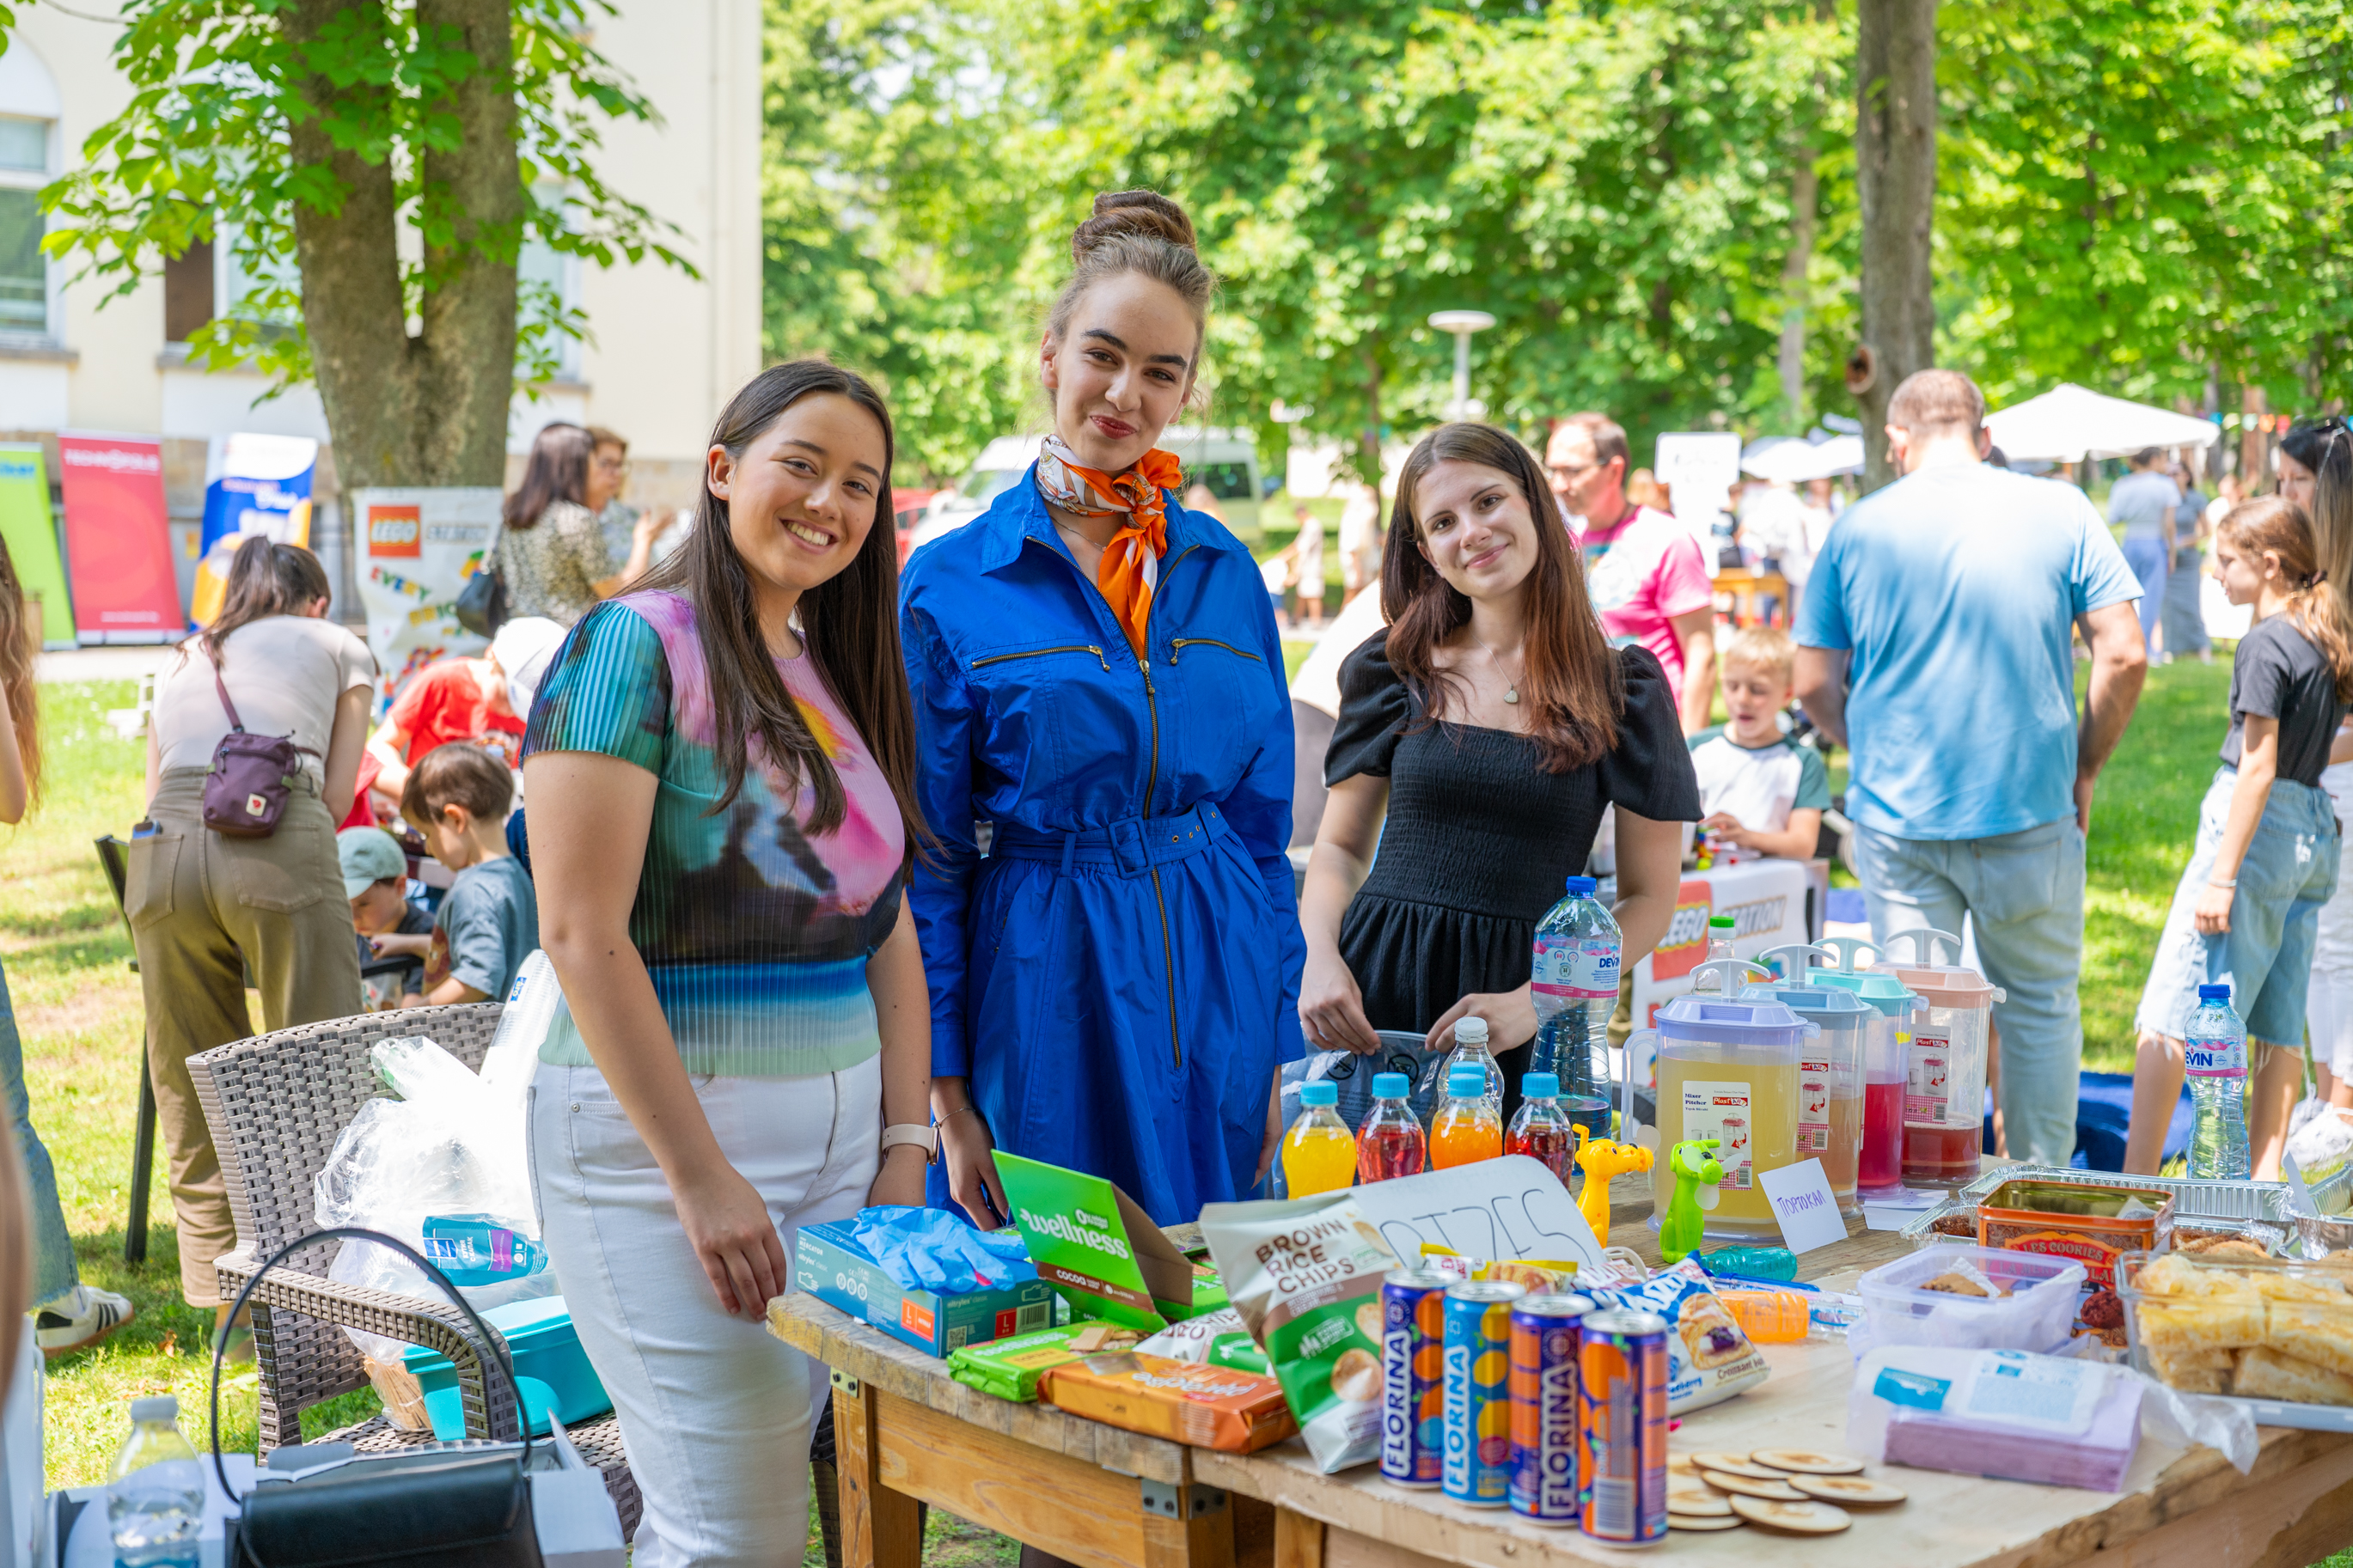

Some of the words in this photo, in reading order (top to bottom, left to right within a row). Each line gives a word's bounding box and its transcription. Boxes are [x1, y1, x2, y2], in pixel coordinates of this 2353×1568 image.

[371, 519, 419, 543] LEGO
[370, 565, 432, 601] EVERY
[408, 601, 456, 628] BRIC
[2185, 1050, 2214, 1066] EVIN
[1776, 1189, 1827, 1218] ПОРТОКАЛ
[798, 1240, 823, 1256] MERCATOR
[1020, 1208, 1129, 1260] wellness
[1256, 1218, 1348, 1264] BROWN
[1266, 1244, 1328, 1278] RICE
[2022, 1241, 2047, 1254] LES
[2049, 1242, 2105, 1261] COOKIES
[1056, 1269, 1086, 1286] cocoa
[1278, 1258, 1355, 1293] CHIPS
[907, 1305, 912, 1319] L
[947, 1298, 970, 1309] nitrylex
[1003, 1315, 1009, 1327] L
[1386, 1335, 1406, 1471] FLORINA
[1446, 1349, 1467, 1487] FLORINA
[1548, 1367, 1572, 1510] FLORINA
